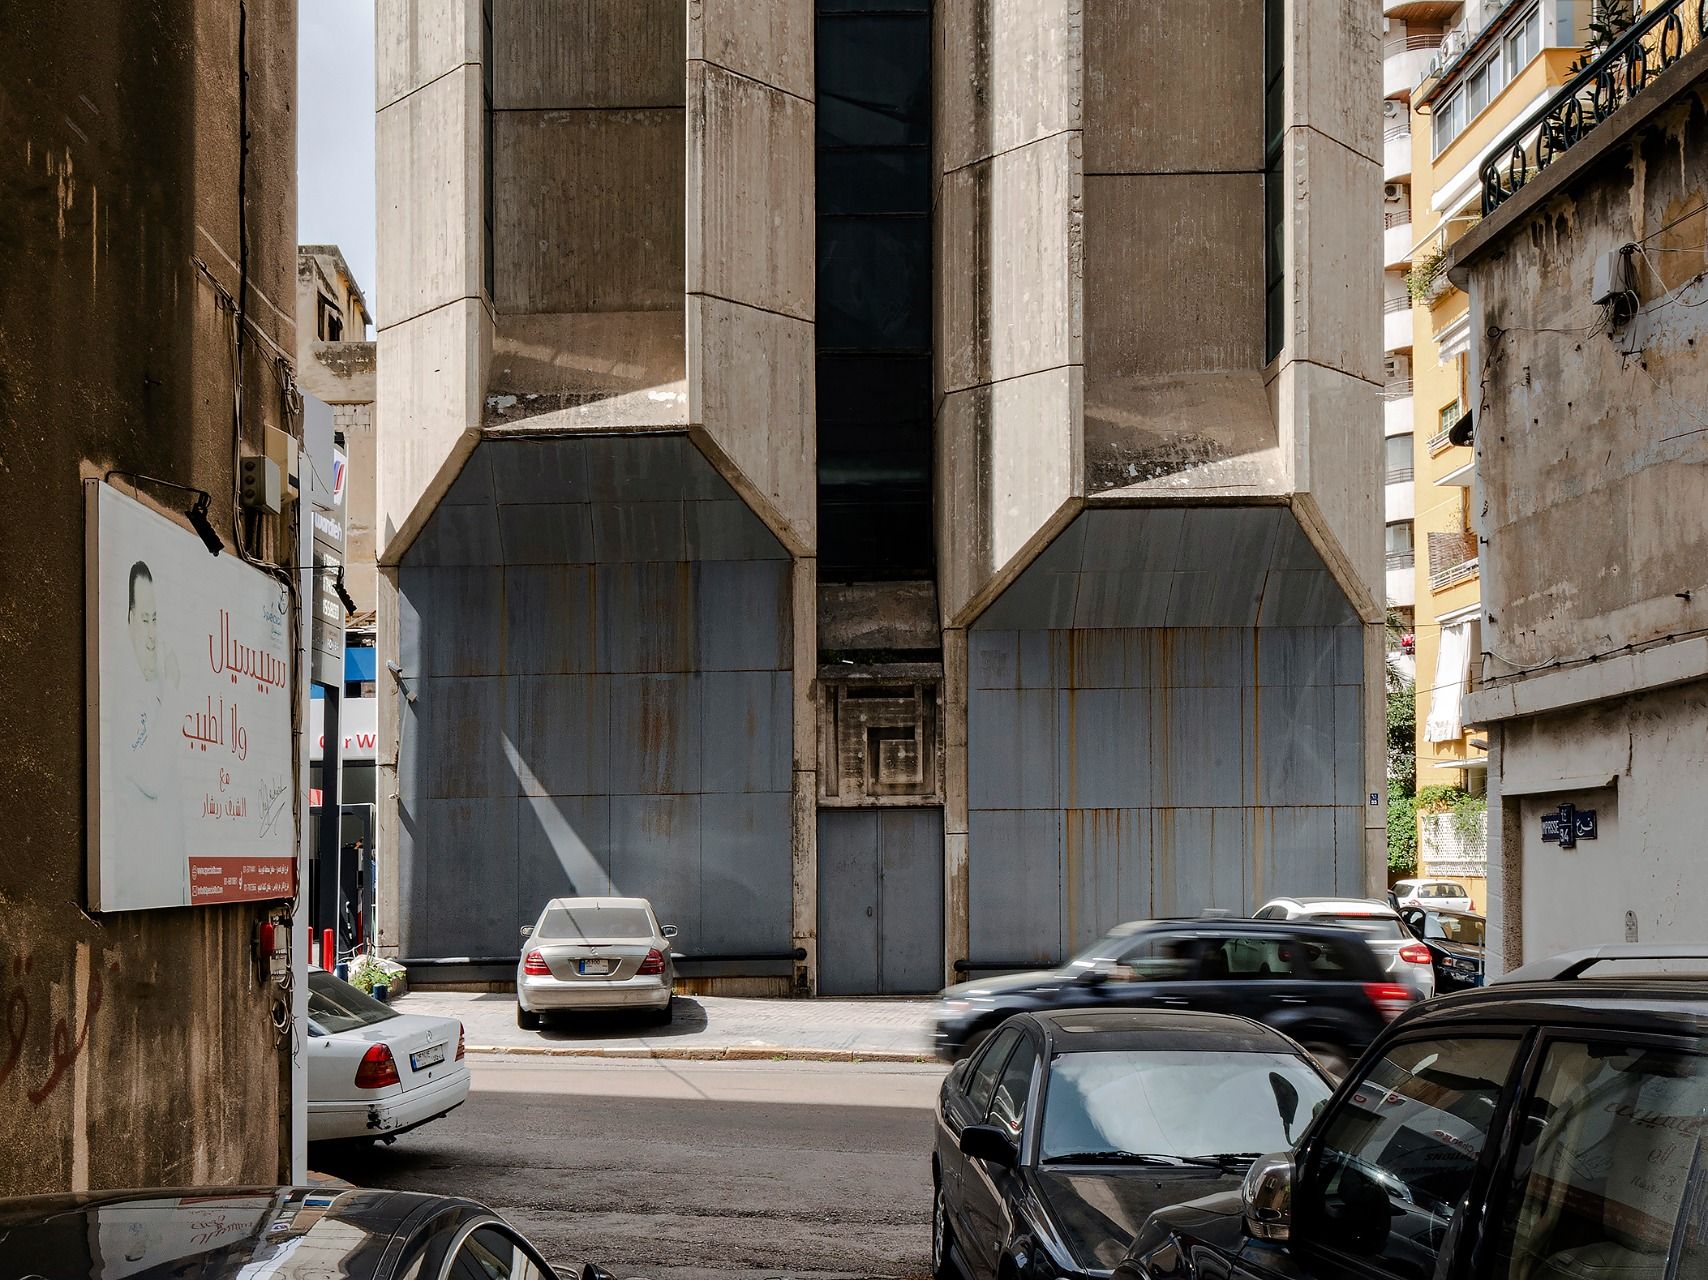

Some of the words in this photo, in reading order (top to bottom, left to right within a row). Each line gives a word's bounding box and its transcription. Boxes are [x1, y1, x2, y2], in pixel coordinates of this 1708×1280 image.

[208, 608, 286, 694] سبيسيال
[182, 694, 224, 753] أطيب
[231, 703, 248, 762] ولا
